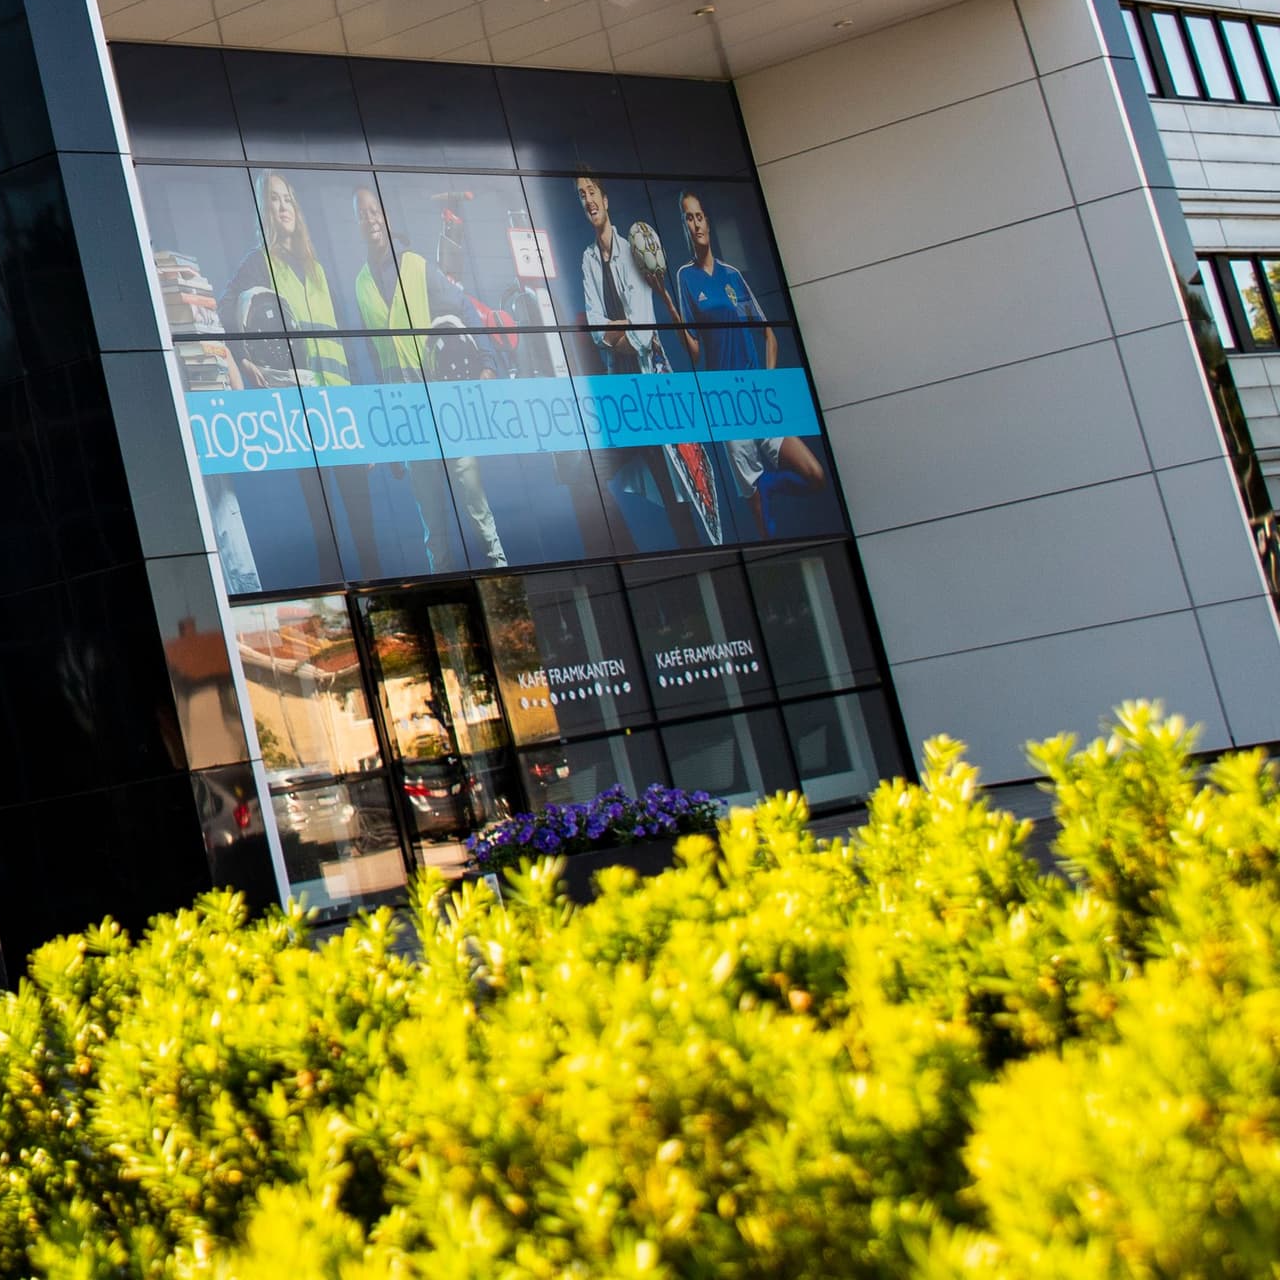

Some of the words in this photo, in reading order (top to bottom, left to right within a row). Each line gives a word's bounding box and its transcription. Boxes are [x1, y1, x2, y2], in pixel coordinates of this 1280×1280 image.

[367, 389, 430, 448] där
[440, 384, 529, 443] olika
[525, 378, 696, 452] perspektiv
[702, 376, 784, 428] möts
[683, 640, 753, 665] FRAMKANTEN
[548, 659, 626, 685] FRAMKANTEN
